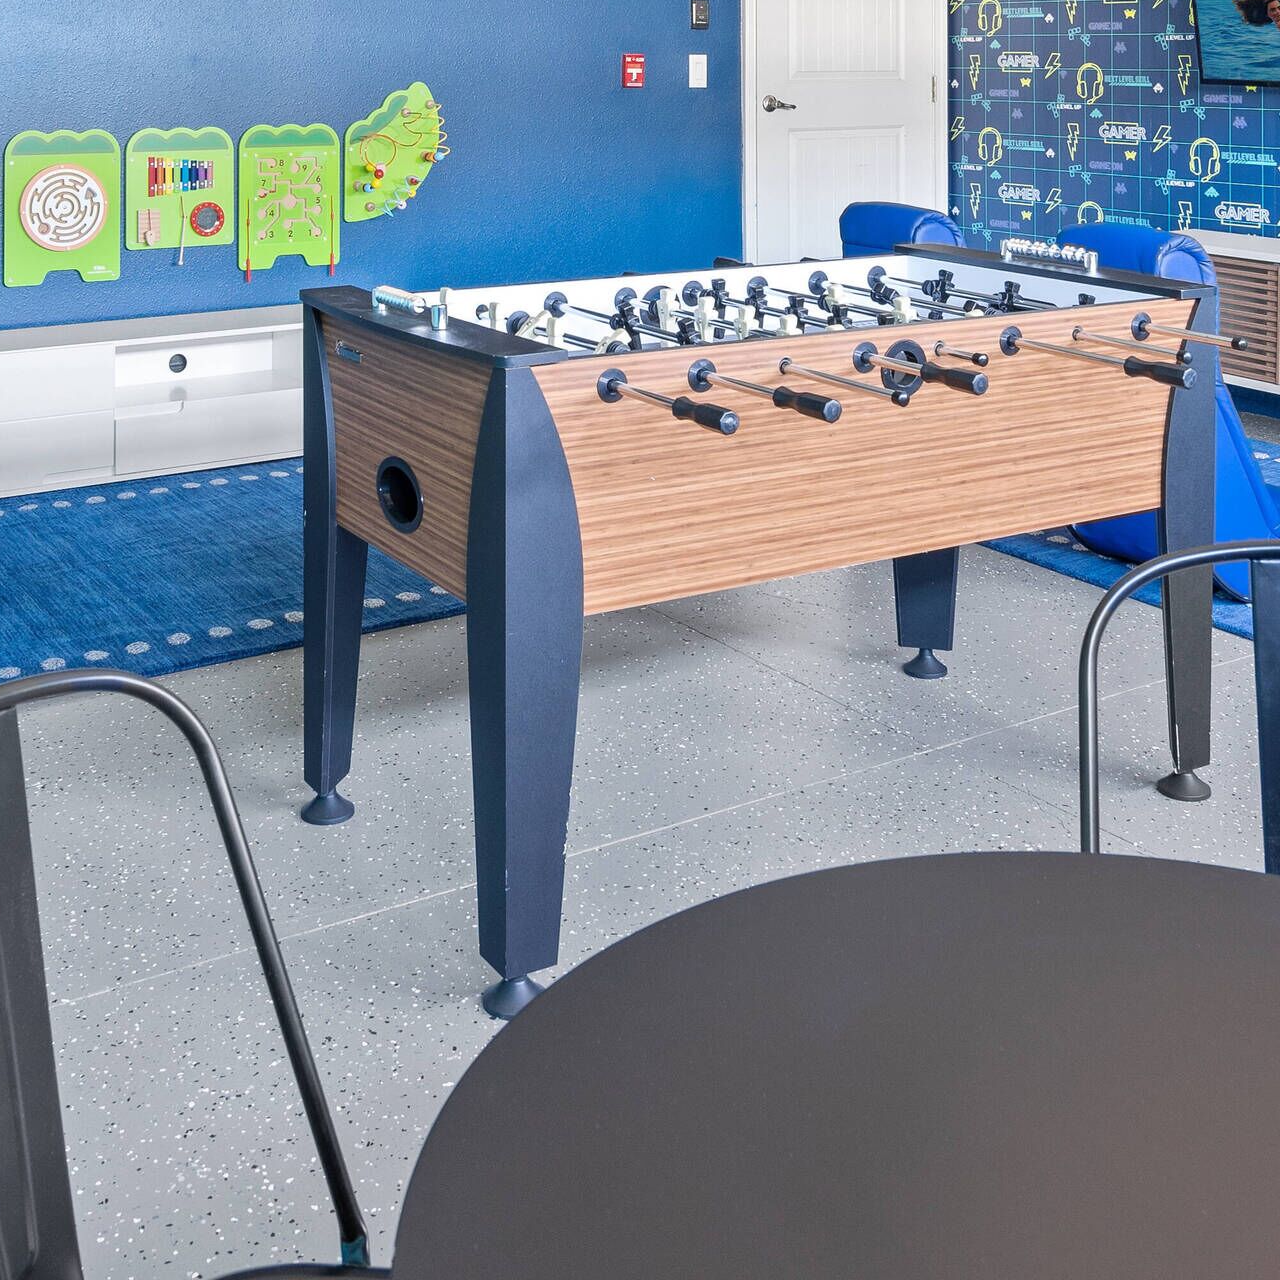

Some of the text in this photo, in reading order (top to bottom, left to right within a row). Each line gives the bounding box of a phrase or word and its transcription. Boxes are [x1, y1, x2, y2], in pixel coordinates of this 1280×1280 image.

[997, 54, 1039, 67] GAMER
[1098, 124, 1146, 140] GAMER
[998, 185, 1040, 201] GAMER
[1215, 204, 1270, 223] GAMER
